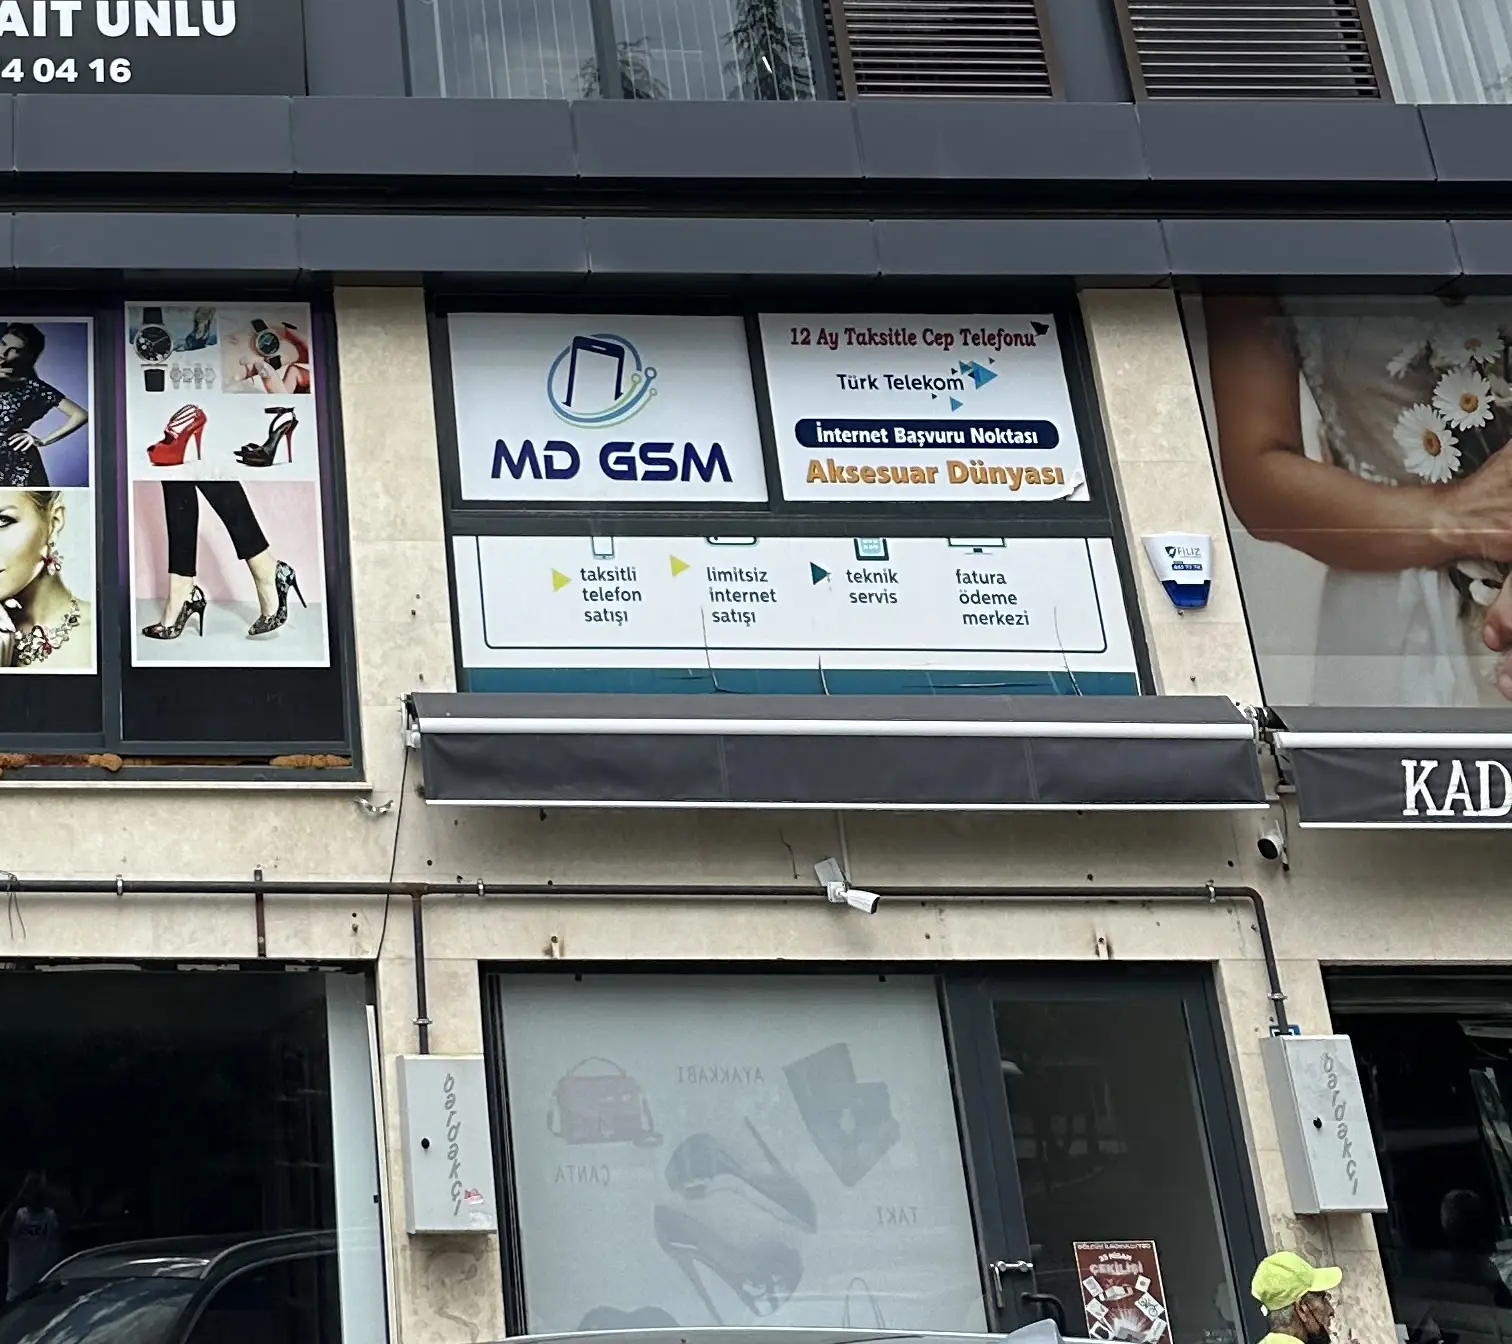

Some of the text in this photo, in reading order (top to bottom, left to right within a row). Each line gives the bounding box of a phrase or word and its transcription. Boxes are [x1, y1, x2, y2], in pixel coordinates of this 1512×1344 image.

[32, 58, 78, 83] 04
[89, 58, 132, 83] 16
[790, 328, 1036, 352] 12 Ay Taksitle Cep Telefonu
[836, 374, 964, 391] Türk Telekom
[816, 421, 1039, 447] İnternet Başvuru Noktası
[491, 438, 732, 482] MD GSM
[806, 458, 1065, 491] Aksesuar Dünyası
[580, 566, 637, 582] taksitli
[706, 567, 768, 582] limitsiz
[846, 568, 900, 584] teknik
[956, 569, 1007, 585] fatura
[582, 587, 642, 602] telefon
[709, 587, 778, 603] internet
[849, 588, 898, 604] servis
[959, 589, 1018, 605] ödeme
[584, 608, 629, 627] satışı
[712, 608, 756, 628] satışı
[962, 610, 1030, 626] merkezi
